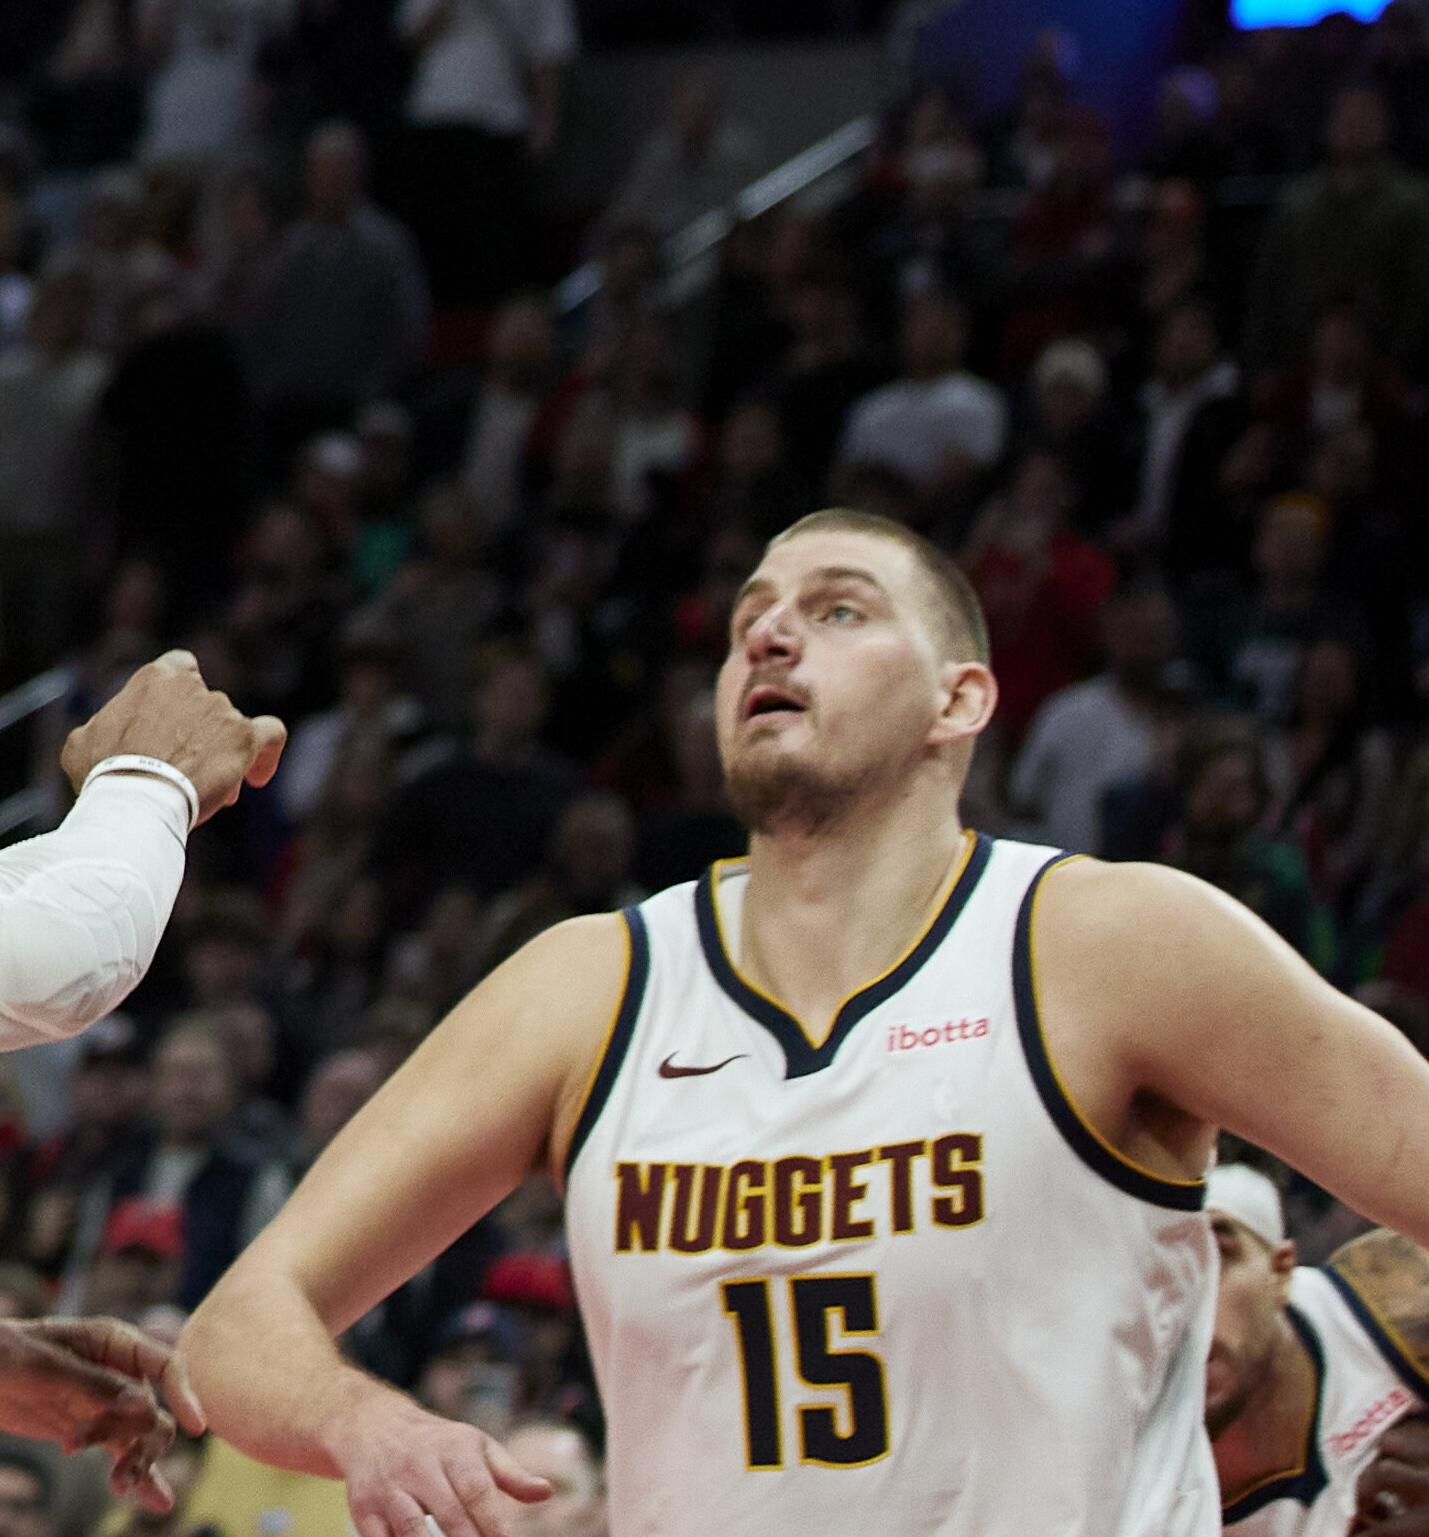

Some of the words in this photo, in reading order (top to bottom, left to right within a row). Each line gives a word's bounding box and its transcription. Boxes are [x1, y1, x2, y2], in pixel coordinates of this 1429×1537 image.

[887, 1018, 989, 1052] ibotta
[614, 1131, 986, 1256] NUGGETS
[720, 1272, 892, 1473] 15
